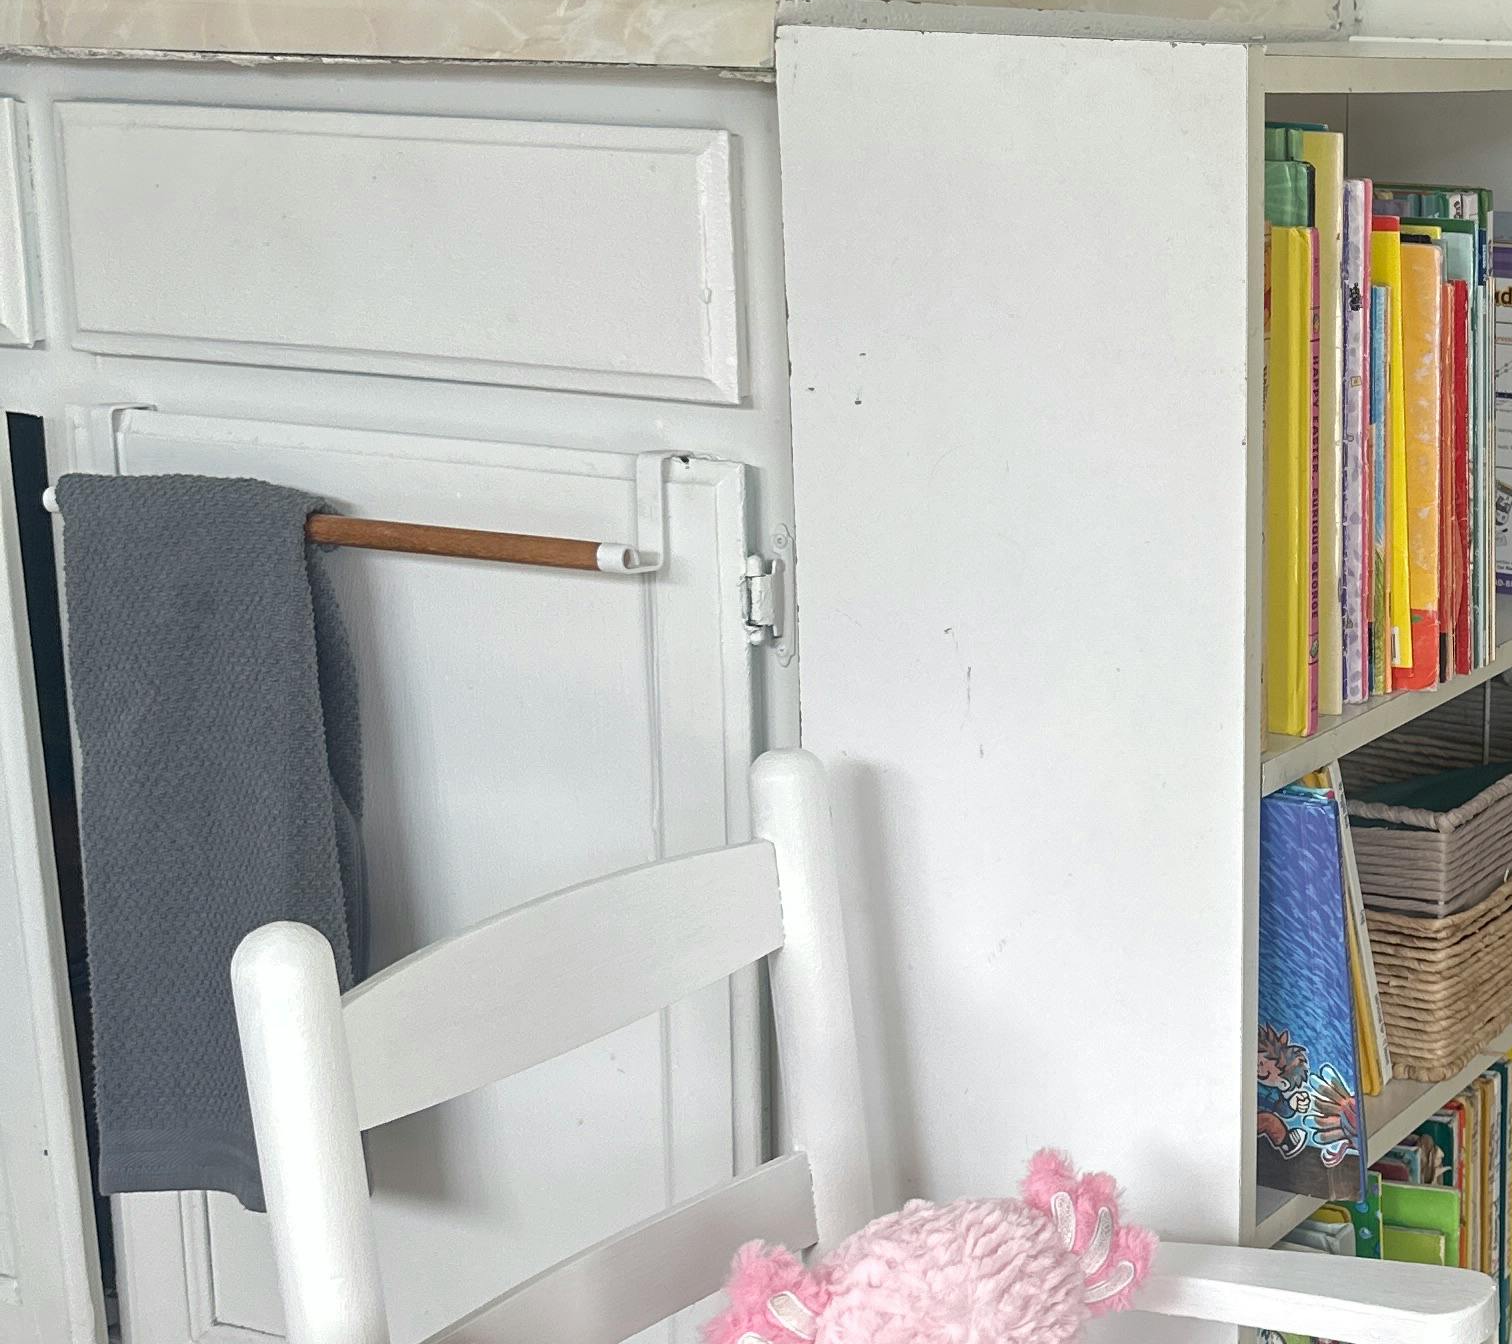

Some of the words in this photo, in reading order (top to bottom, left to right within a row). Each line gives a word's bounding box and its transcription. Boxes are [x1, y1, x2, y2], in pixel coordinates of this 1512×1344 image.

[1311, 355, 1320, 408] HAPPY
[1311, 415, 1320, 480] EASTER,
[1311, 488, 1320, 555] CURIOUS
[1311, 561, 1320, 619] GEORGE
